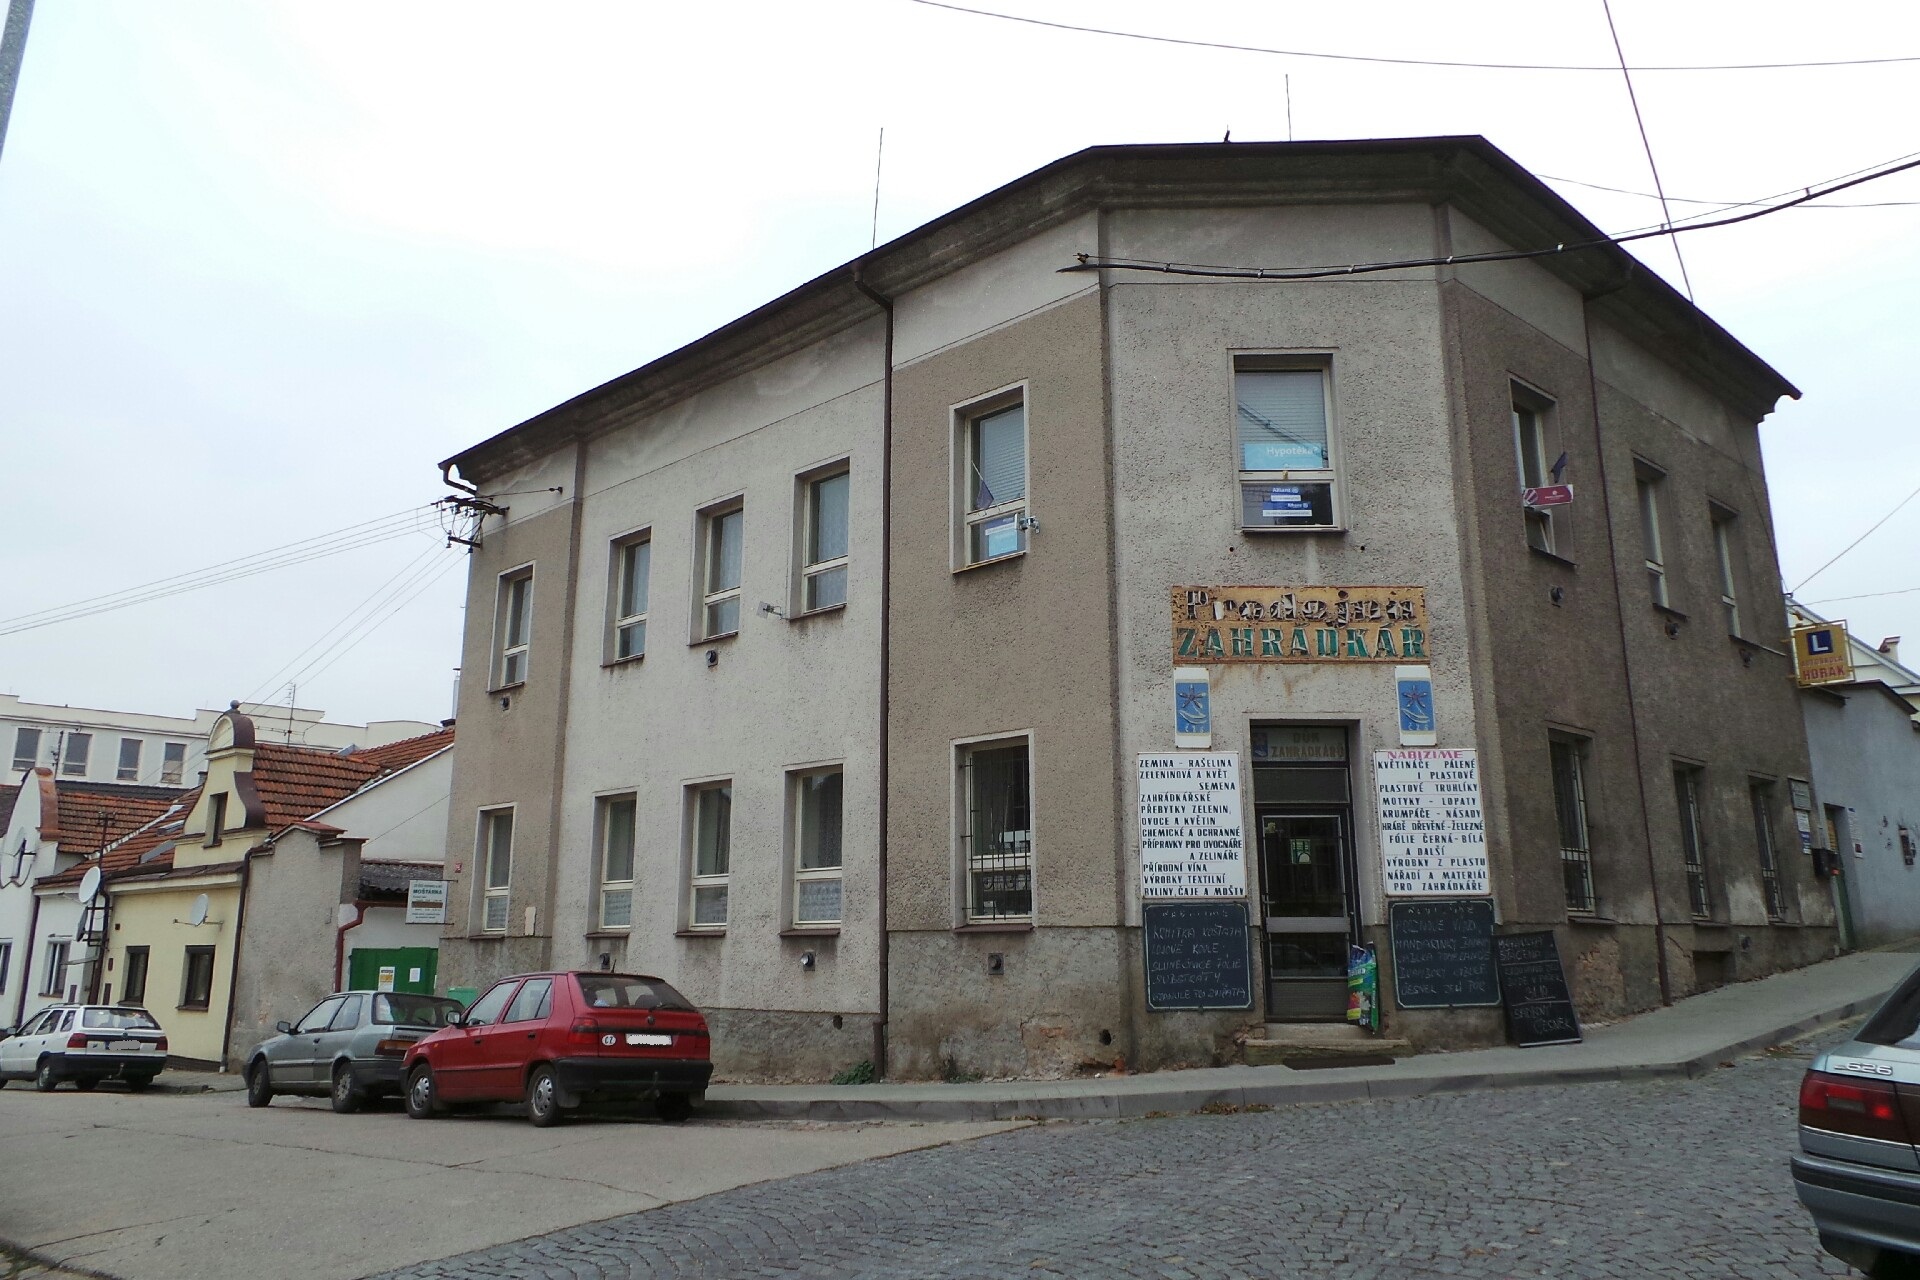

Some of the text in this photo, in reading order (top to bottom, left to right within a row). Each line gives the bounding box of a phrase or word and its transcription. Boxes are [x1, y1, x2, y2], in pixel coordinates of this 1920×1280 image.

[1185, 590, 1416, 628] Prodejna
[1189, 758, 1232, 767] RAŠELINA
[1378, 759, 1475, 769] KVĚTINÁČE PÁLENÉ
[1140, 769, 1191, 779] ZELENINOVÁ
[1207, 769, 1227, 778] KVĚT
[1430, 769, 1474, 779] PLASTOVÉ
[1380, 782, 1477, 792] PLASTOVÉ TRUHLÍKY
[1141, 792, 1211, 802] ZAHRÁDKÁŘSKÉ
[1141, 804, 1185, 813] PŘEBYTKY
[1382, 808, 1430, 818] KRUMPÁČE
[1446, 808, 1481, 818] NÁSADY
[1185, 815, 1215, 825] KVĚTIN
[1382, 821, 1406, 830] HRÁBĚ
[1452, 820, 1484, 830] ŽELEZNÉ
[1143, 827, 1184, 836] CHEMICKÉ
[1198, 827, 1240, 836] OCHRANNÉ
[1143, 839, 1182, 848] PŘÍPRAVKY
[1204, 838, 1242, 848] OVOCNÁŘE
[1390, 834, 1415, 843] FÓLIE
[1423, 833, 1452, 843] ČERNÁ
[1462, 834, 1483, 843] BÍLÁ
[1199, 850, 1238, 860] ZELINÁŘE
[1418, 846, 1445, 855] DALŠÍ
[1143, 862, 1207, 872] PŘÍRODNÍ VÍNA
[1387, 857, 1428, 867] VÝROBKY
[1451, 858, 1485, 866] PLASTU
[1144, 873, 1225, 884] VÝROBKY TEXTILNÍ
[1388, 870, 1420, 879] NÁŘADÍ
[1443, 869, 1487, 879] MATERIÁL
[1214, 885, 1243, 895] MOŠTY
[1422, 880, 1482, 890] ZAHRÁDKÁŘE
[1846, 1062, 1893, 1076] 626
